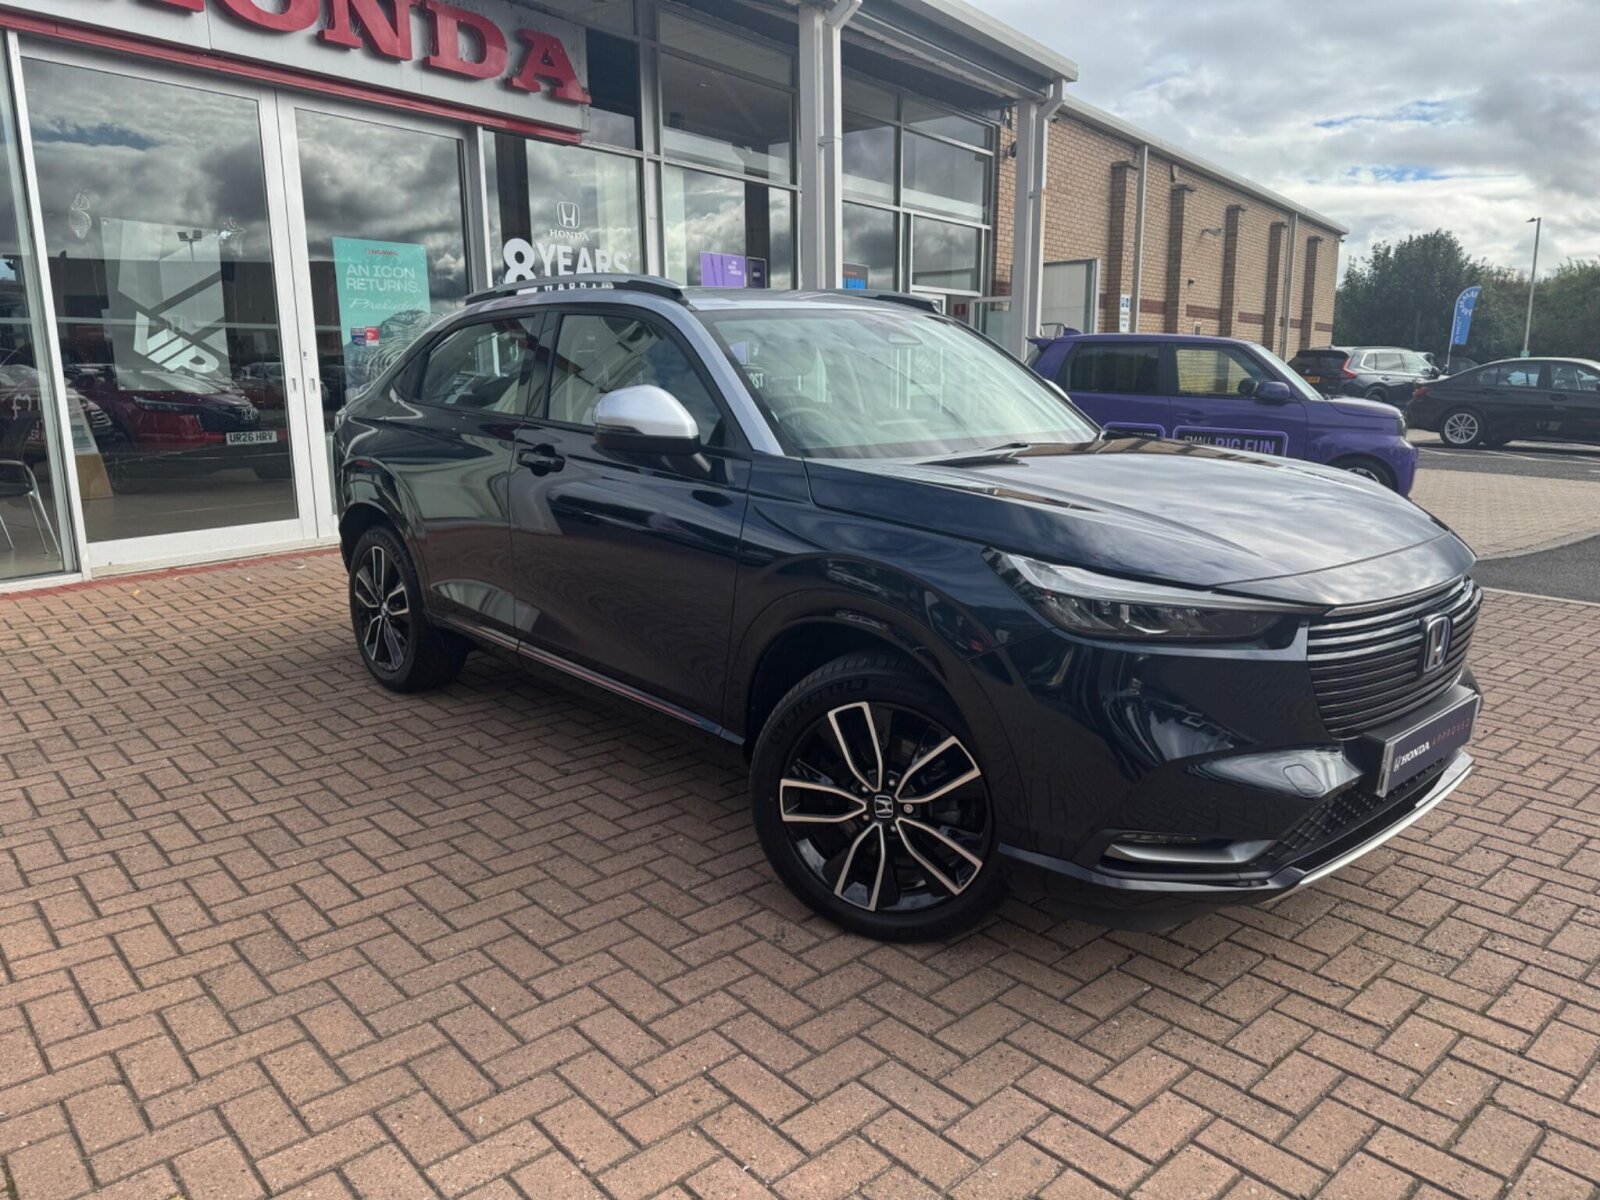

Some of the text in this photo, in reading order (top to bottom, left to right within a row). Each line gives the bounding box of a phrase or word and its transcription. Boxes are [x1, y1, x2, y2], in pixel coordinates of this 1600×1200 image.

[158, 0, 591, 104] NDA
[549, 229, 590, 241] HONDA
[346, 264, 415, 279] AN ICON
[503, 238, 538, 295] 8
[1245, 440, 1275, 455] FUN
[1401, 741, 1430, 766] HONDA
